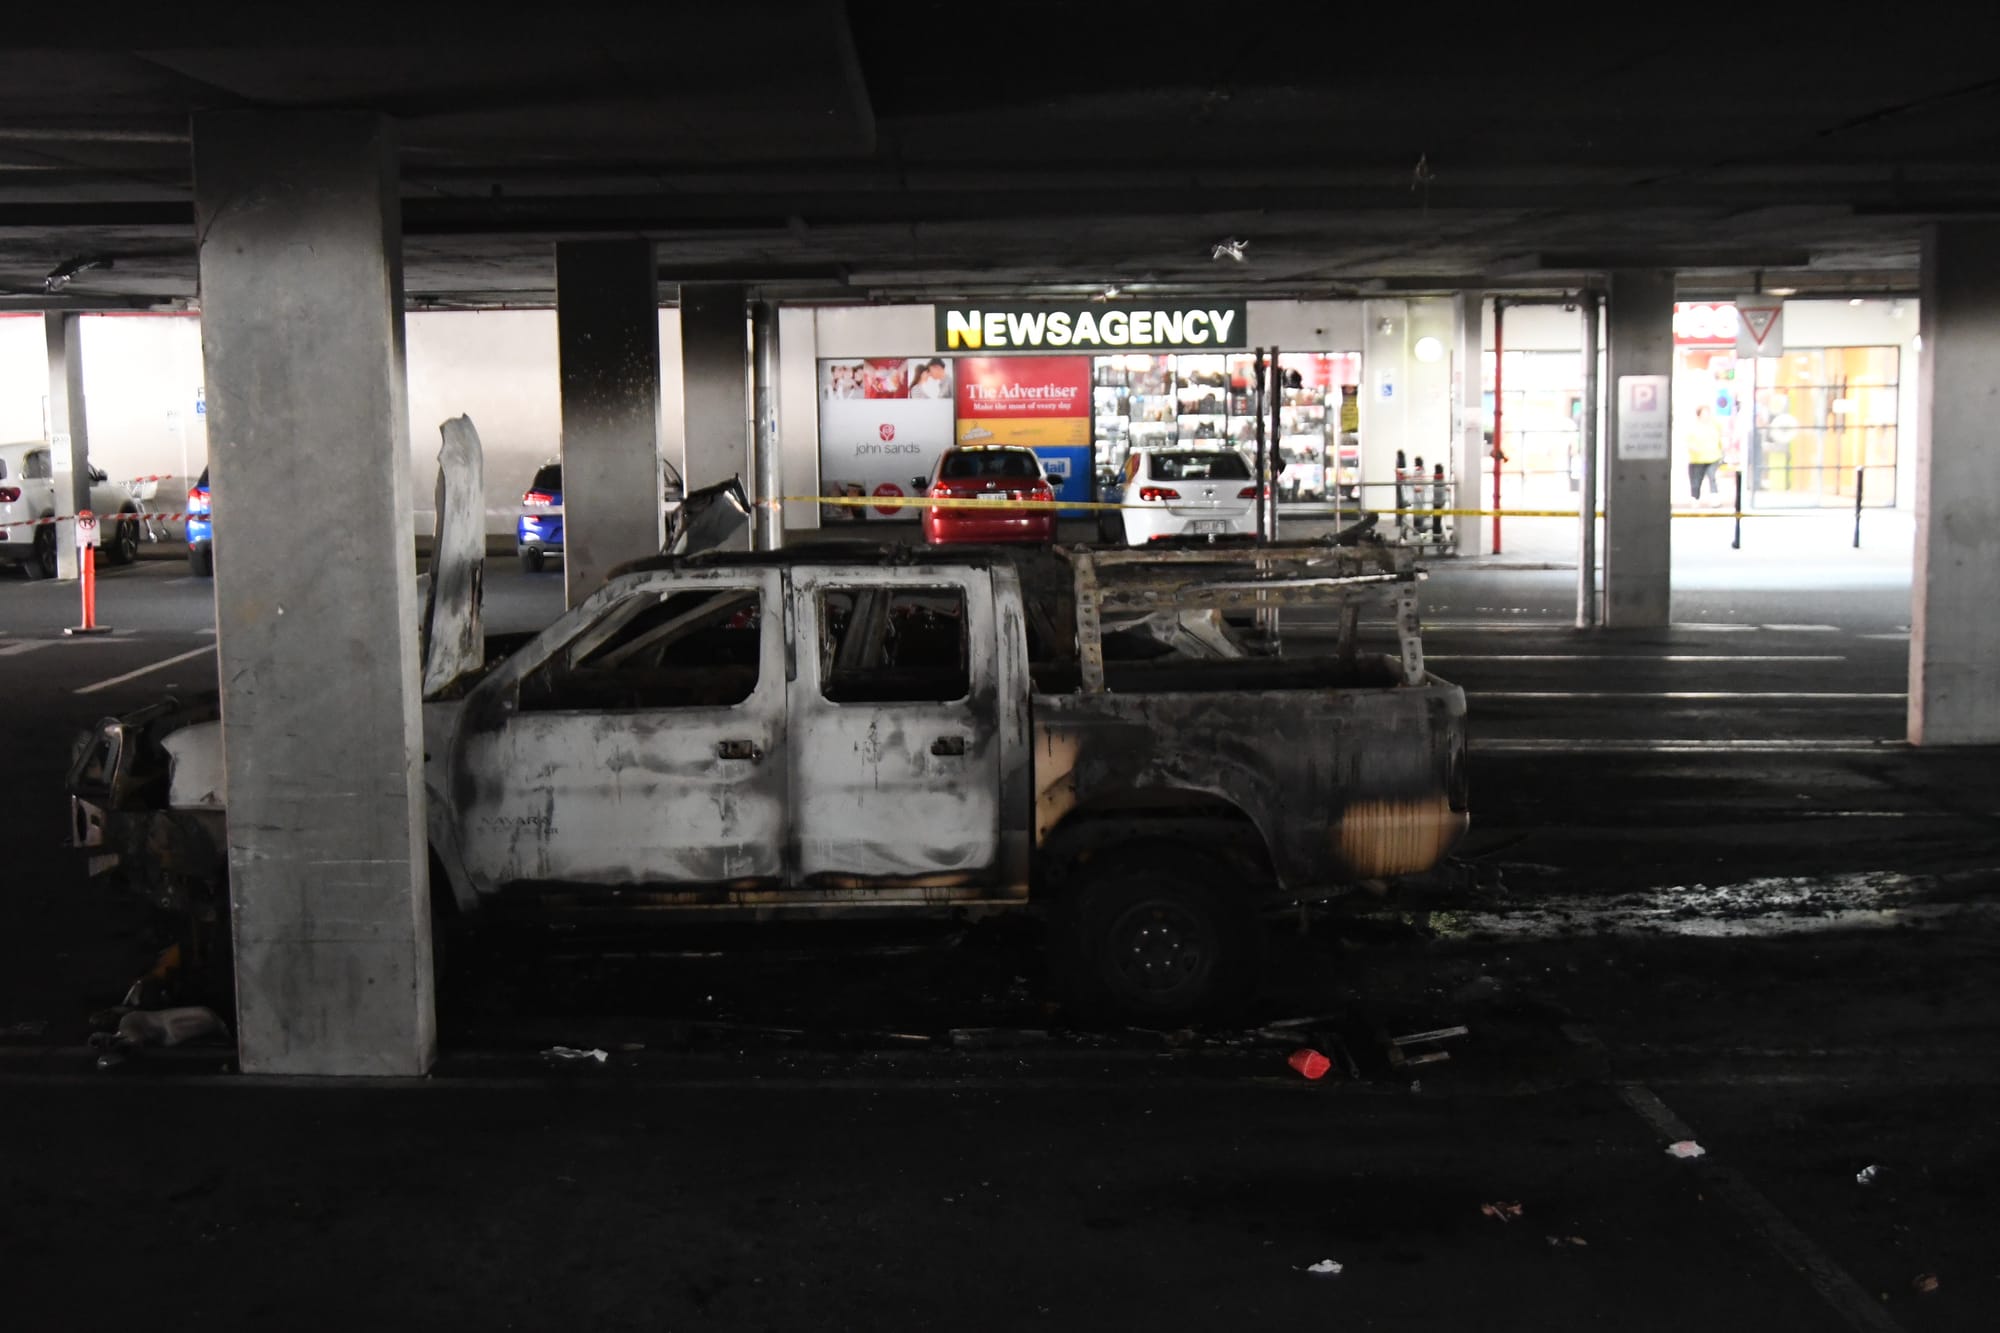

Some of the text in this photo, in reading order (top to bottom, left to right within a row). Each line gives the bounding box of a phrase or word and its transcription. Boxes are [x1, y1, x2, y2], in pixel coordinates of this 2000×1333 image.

[946, 309, 1236, 349] NEWSAGENCY
[966, 383, 1077, 399] The Advertiser
[973, 401, 1071, 411] Make the most of every day
[854, 442, 921, 456] john sands
